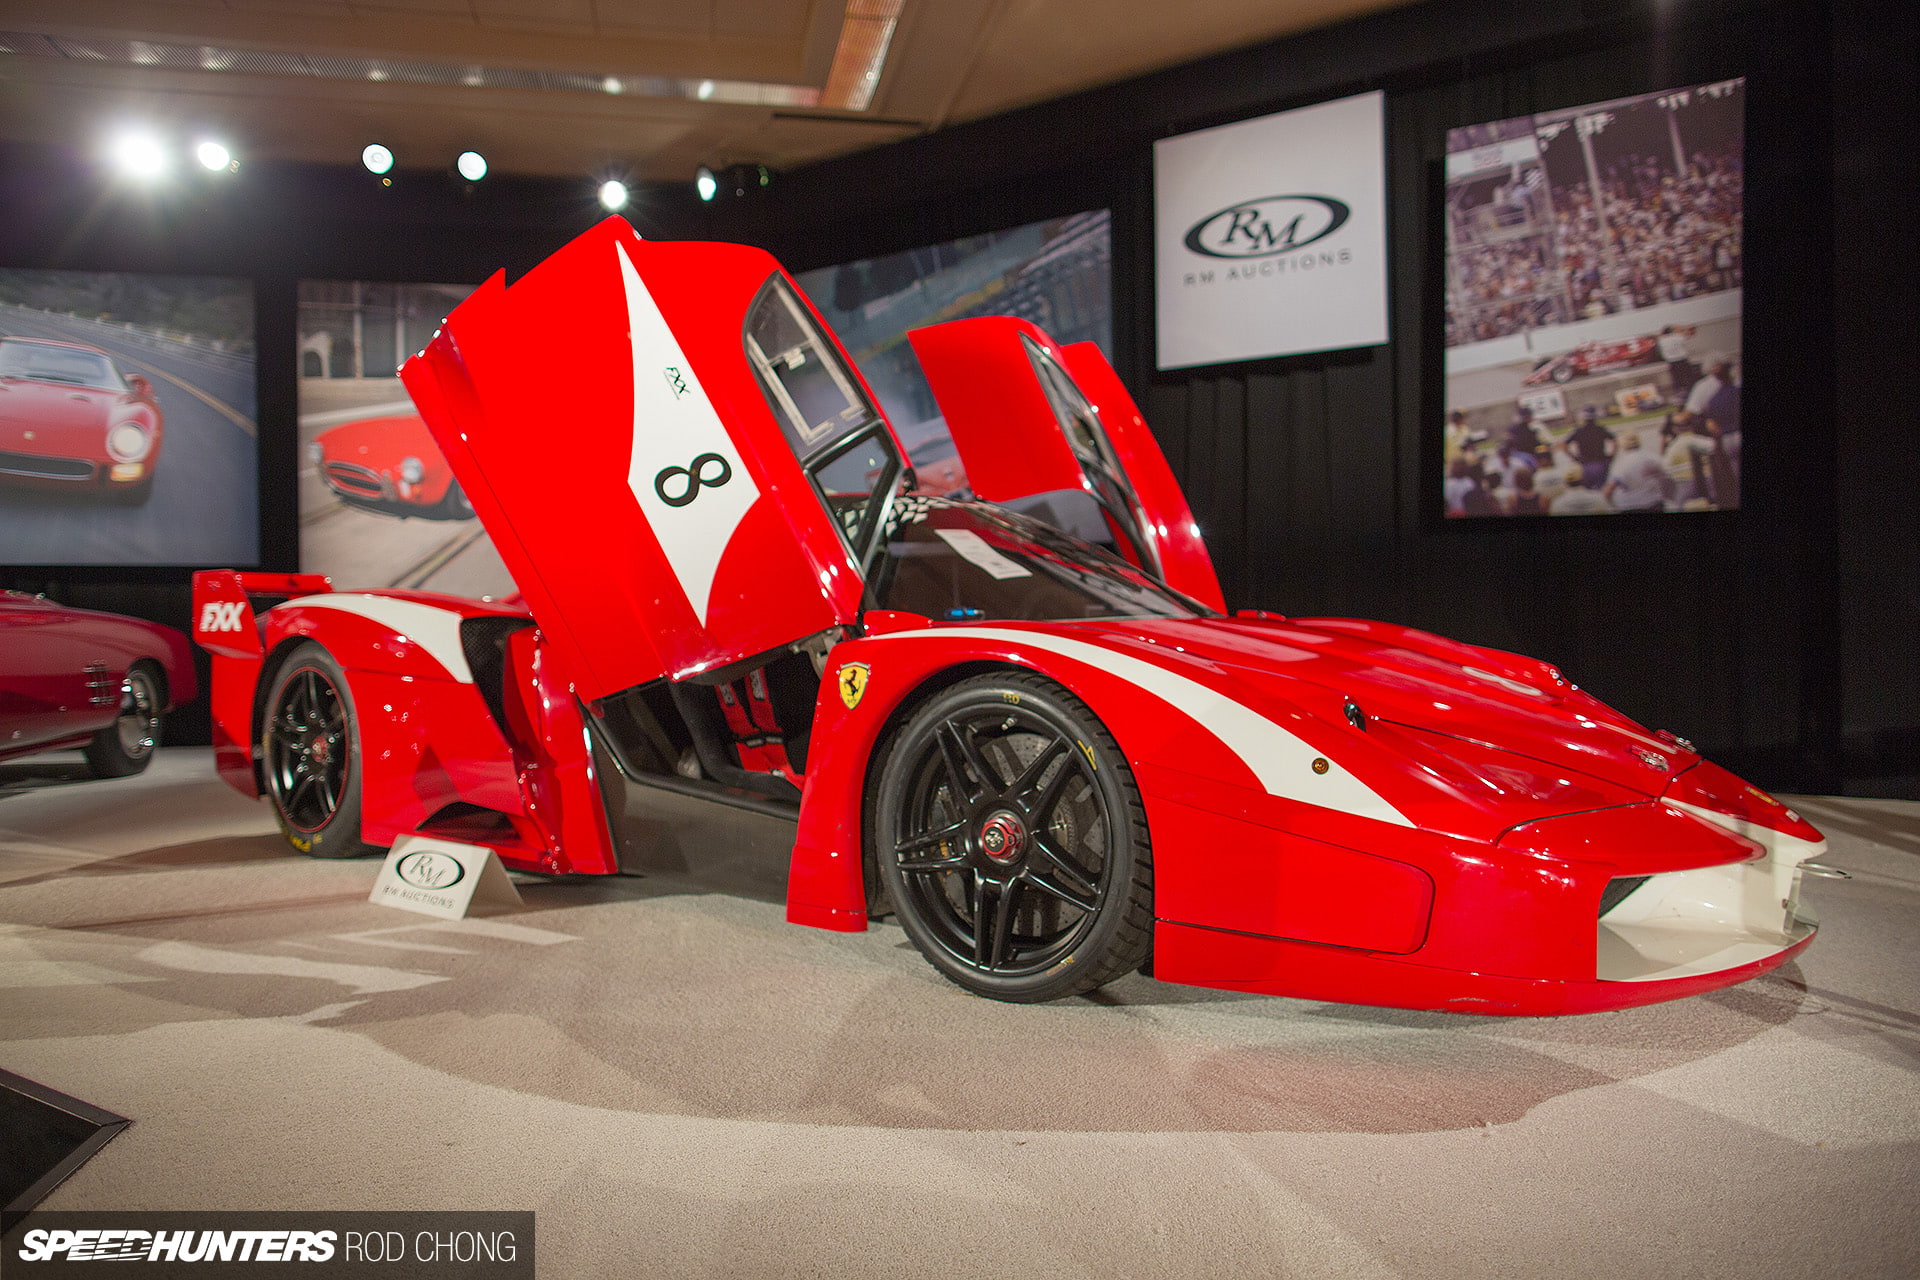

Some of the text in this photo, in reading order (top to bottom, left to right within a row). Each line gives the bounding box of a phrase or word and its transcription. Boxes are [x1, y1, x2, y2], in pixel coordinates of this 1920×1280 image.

[1220, 208, 1304, 250] RM
[1184, 248, 1353, 287] RM AUCTIONS
[665, 366, 691, 394] FXX
[654, 452, 732, 507] 8
[199, 601, 246, 633] FXX
[409, 854, 447, 887] RM
[400, 888, 455, 909] AUCTIONS
